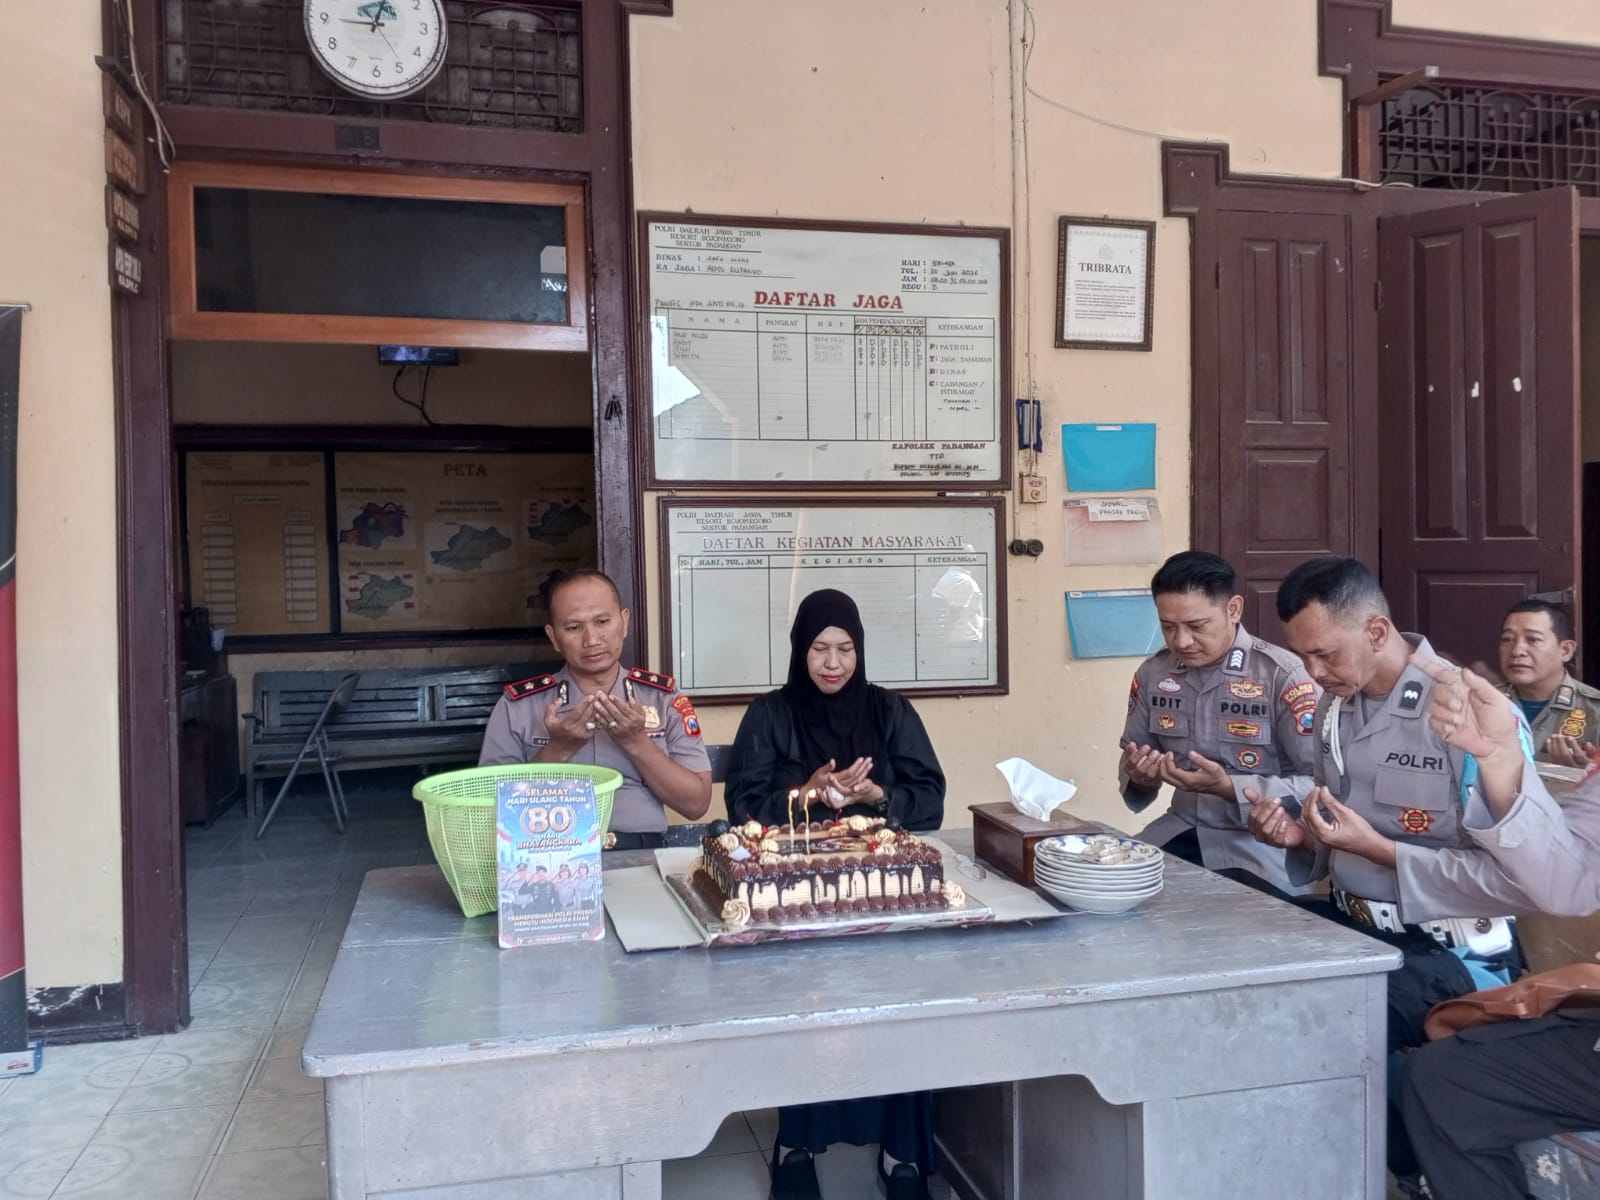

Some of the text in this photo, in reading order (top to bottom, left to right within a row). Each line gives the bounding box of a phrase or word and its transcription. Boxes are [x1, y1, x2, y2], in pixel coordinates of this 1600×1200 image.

[412, 0, 421, 10] 2
[320, 12, 329, 24] 9
[419, 23, 428, 35] 3
[327, 37, 337, 50] 8
[412, 47, 421, 57] 4
[346, 55, 358, 69] 7
[395, 62, 404, 74] 5
[372, 66, 381, 78] 6
[679, 227, 710, 235] DAERAH
[670, 233, 746, 243] RESORT BOJONEGORO
[1079, 262, 1132, 275] TRIBRATA
[754, 291, 836, 307] DAFTAR
[853, 294, 903, 309] JAGA
[766, 319, 799, 327] PANGKAT
[443, 463, 487, 478] PETA
[703, 535, 964, 550] DAFTAR KEGIATAN MASYARAKAT
[1152, 696, 1181, 709] EDIT
[1221, 702, 1266, 716] POLRI
[1385, 752, 1443, 770] POLRI
[524, 788, 568, 796] SELAMAT
[507, 797, 527, 805] HARI
[529, 796, 558, 804] ULANG
[528, 806, 569, 832] 80
[517, 838, 582, 849] BHAYANGKARA
